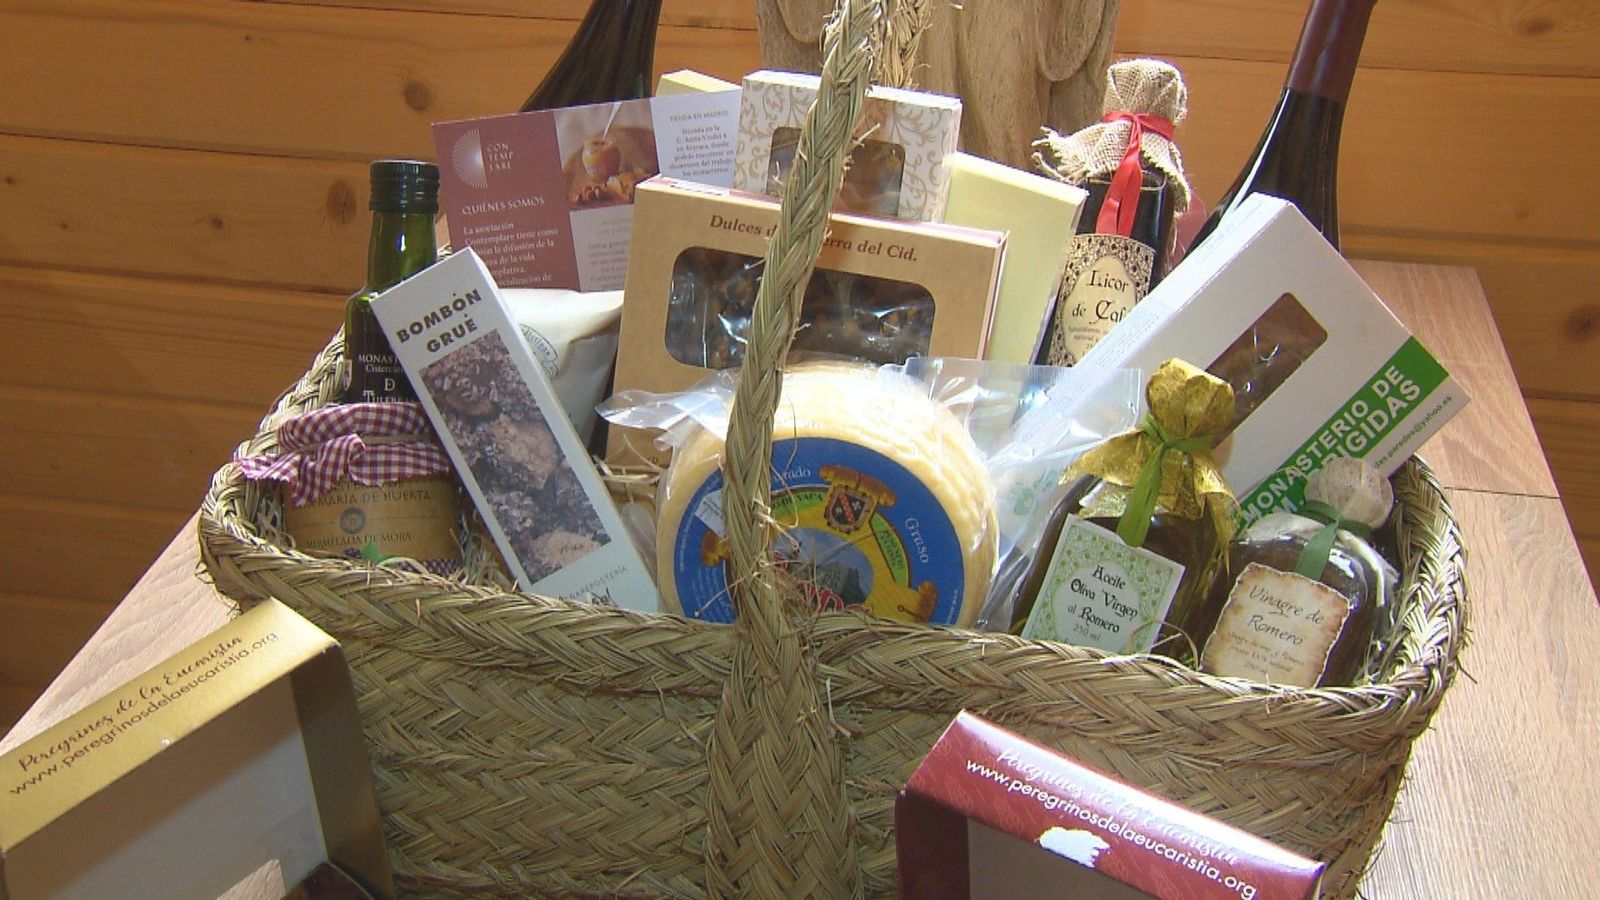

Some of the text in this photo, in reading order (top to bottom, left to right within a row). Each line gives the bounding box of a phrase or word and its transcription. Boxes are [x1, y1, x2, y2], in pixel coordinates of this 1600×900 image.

[507, 197, 545, 209] SOMOS
[520, 252, 535, 262] vida
[536, 239, 545, 248] de
[547, 238, 554, 246] la
[710, 215, 917, 261] Dulces d erra del Cid.
[1088, 270, 1129, 292] Licor
[397, 288, 481, 344] BOMBÓN
[1072, 300, 1127, 324] de Caf
[427, 314, 478, 352] GRUÉ
[358, 353, 400, 363] MONAST
[1243, 365, 1404, 524] MONASTERIO DE
[1308, 379, 1421, 477] IGIDAS
[362, 491, 379, 503] DE
[384, 489, 431, 502] HUERTA
[306, 535, 361, 549] MERMELADA
[382, 531, 412, 543] MORA
[905, 518, 929, 563] Graso
[1092, 565, 1126, 590] Aceite
[1067, 604, 1120, 633] al Romero
[1070, 578, 1138, 621] Oliva Virgen
[1249, 585, 1325, 625] Vinagre de
[1247, 614, 1304, 645] Romero
[9, 632, 278, 795] www.peregrinosdelaeucaristia.org
[18, 714, 114, 772] Peregrinos
[115, 699, 138, 715] de
[139, 684, 162, 700] la
[996, 748, 1084, 799] Peregrinos
[966, 759, 1257, 900] www.peregrinosdelaeucaristia.org
